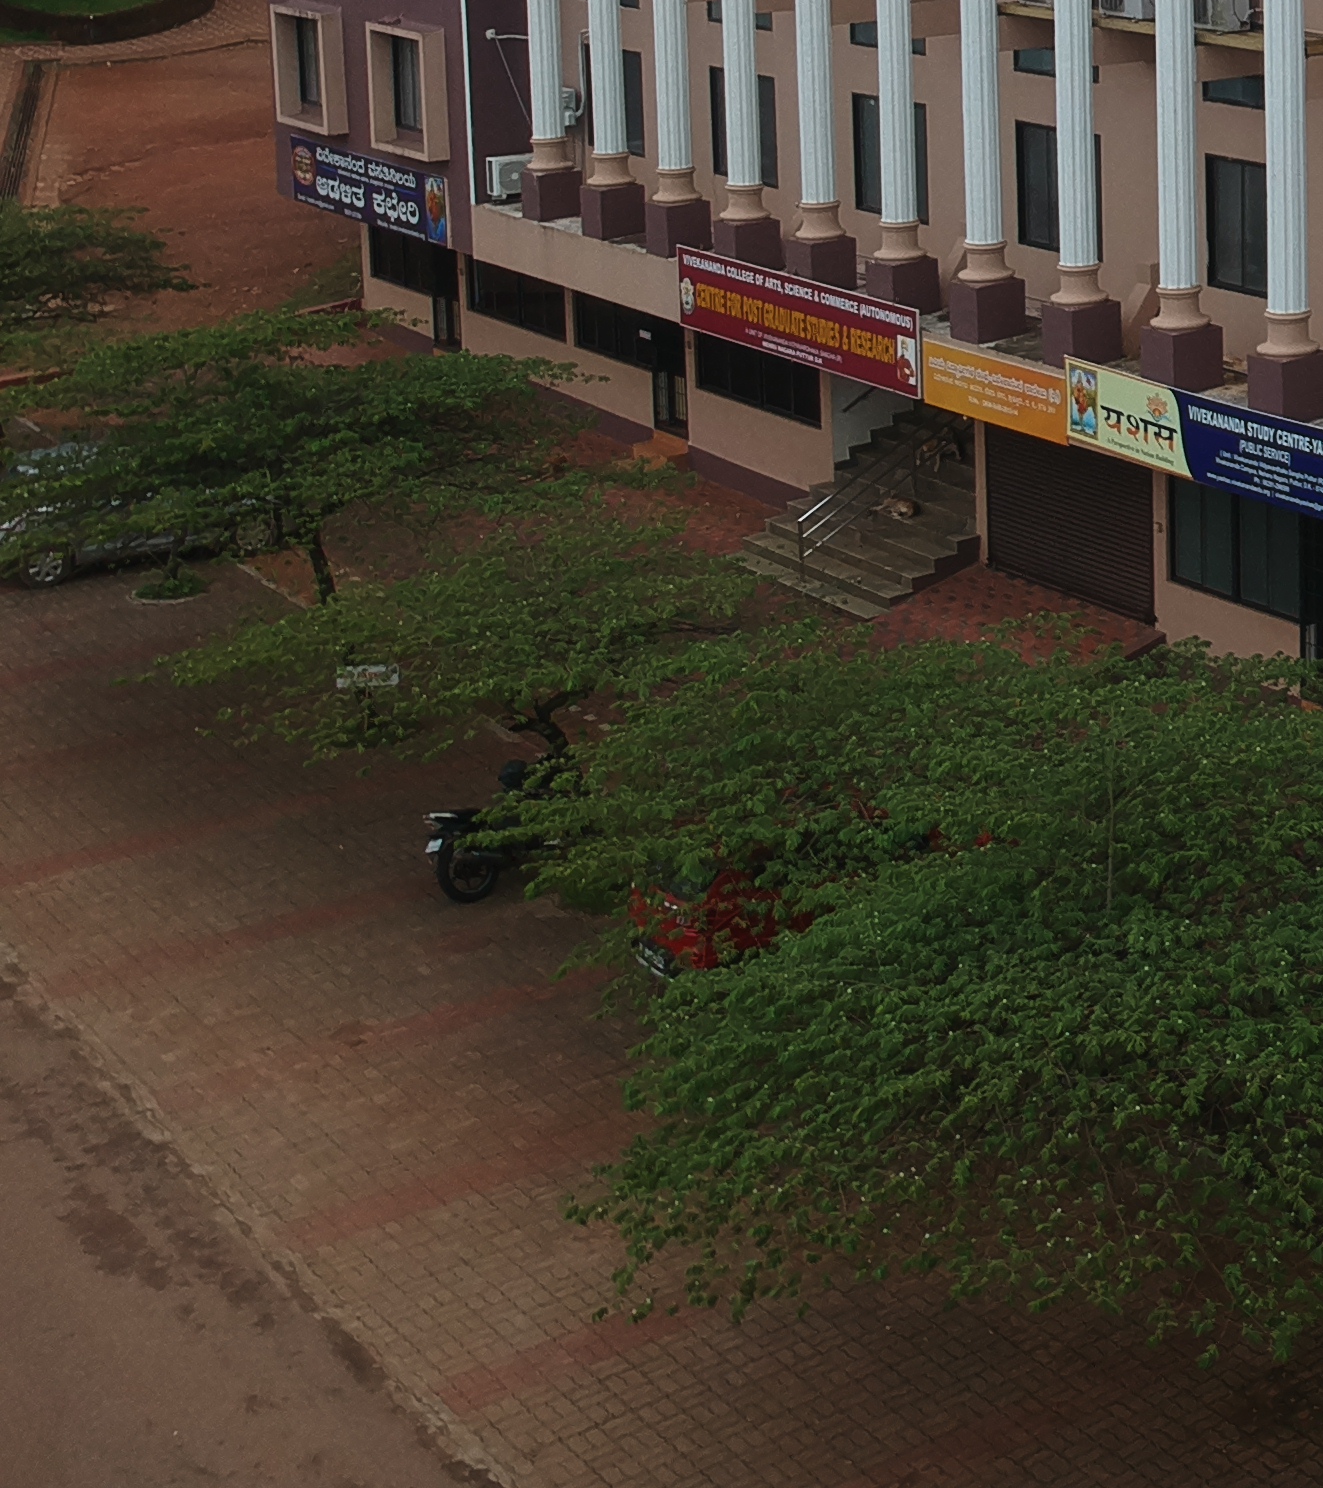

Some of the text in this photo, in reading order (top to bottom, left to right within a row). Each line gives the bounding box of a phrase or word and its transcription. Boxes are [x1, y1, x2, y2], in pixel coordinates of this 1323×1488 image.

[316, 175, 365, 208] ಆಡಳಿತ
[683, 253, 914, 332] VIVEKANANDA COLLEGE OF ARTS, SCIENCE & COMMERCE (AUTONOMOUS)
[696, 282, 896, 365] CENTRE FOR POST GRADUATE STUDIES & RESEARCH
[1100, 405, 1178, 452] यशस
[1187, 404, 1246, 435] VIVEKANANDA
[1247, 421, 1275, 443] STUDY
[1239, 439, 1291, 467] (PUBLIC SERVICE)
